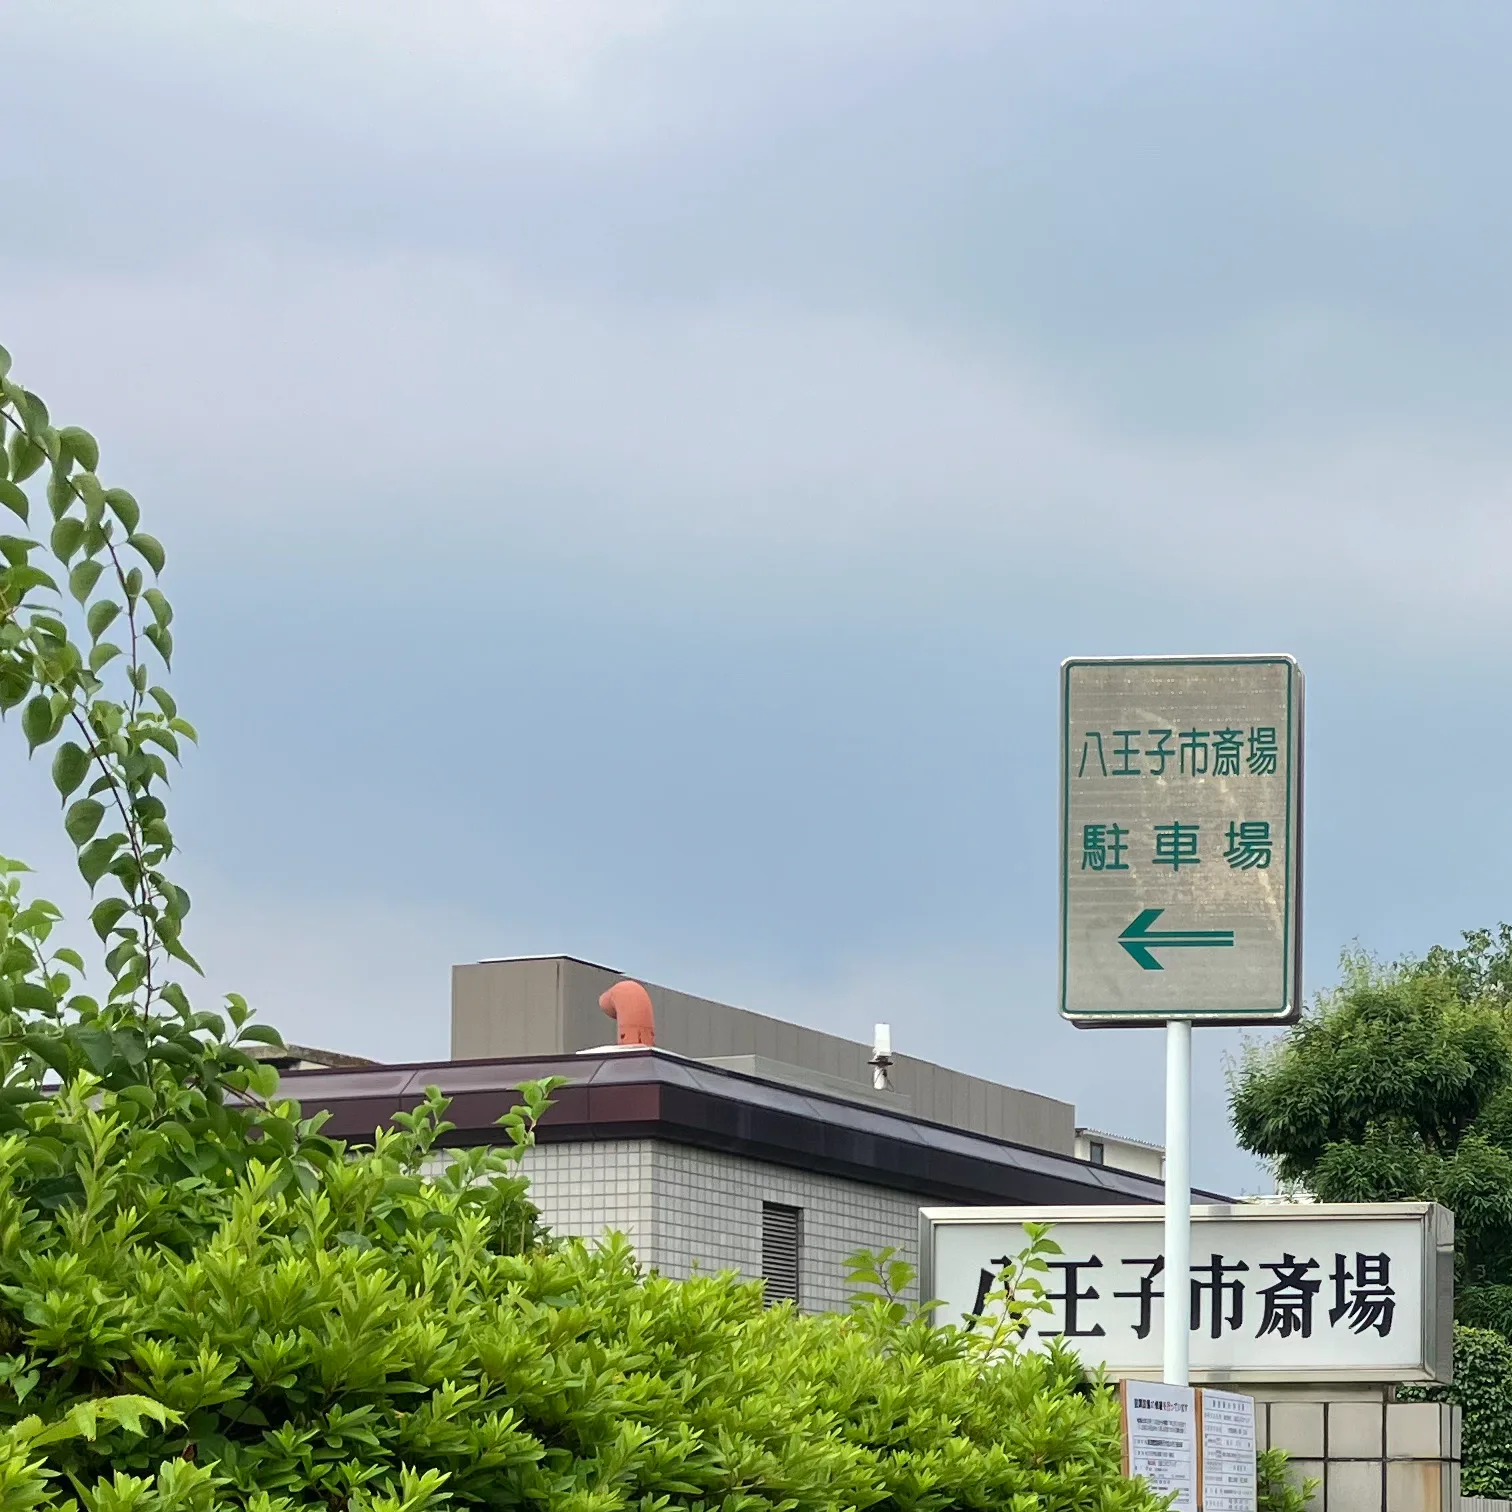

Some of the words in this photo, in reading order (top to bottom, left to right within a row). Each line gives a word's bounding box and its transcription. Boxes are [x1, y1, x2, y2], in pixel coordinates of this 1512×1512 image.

[1078, 727, 1278, 777] 八王子市斎場
[1081, 820, 1273, 872] 駐車場
[964, 1251, 1396, 1340] 八王子市斎場
